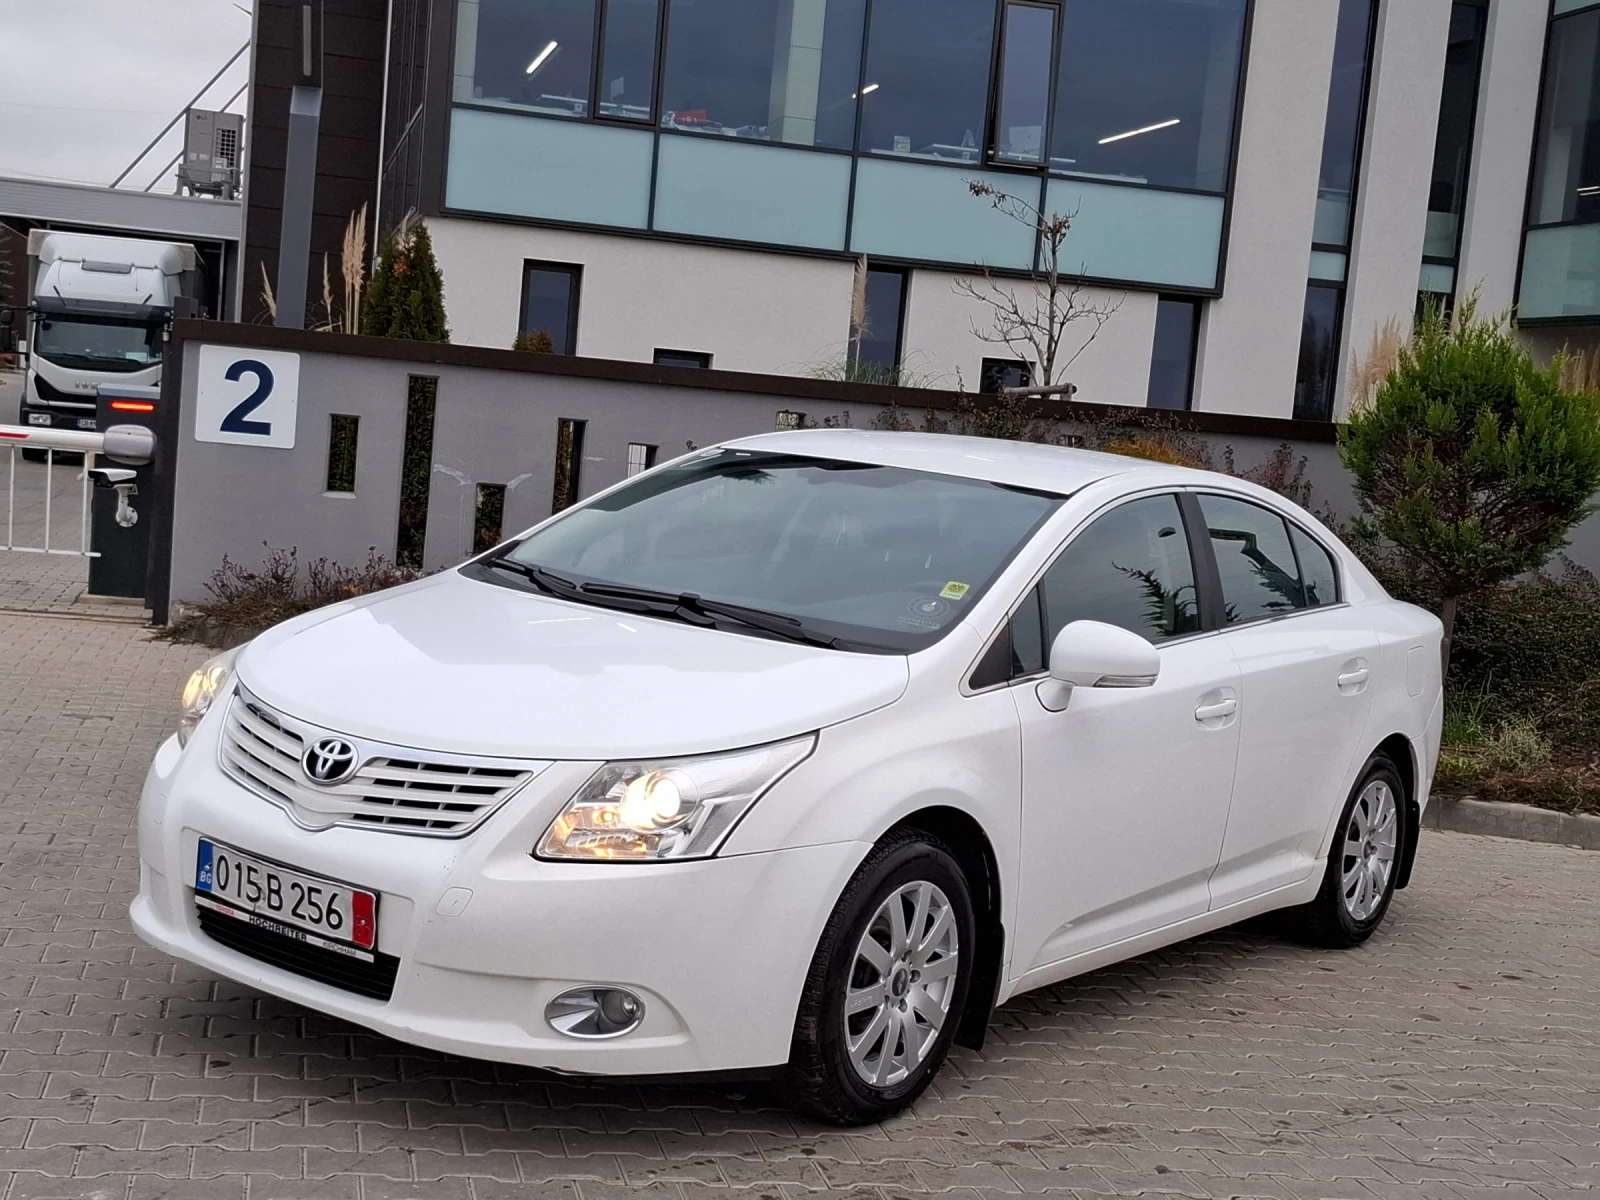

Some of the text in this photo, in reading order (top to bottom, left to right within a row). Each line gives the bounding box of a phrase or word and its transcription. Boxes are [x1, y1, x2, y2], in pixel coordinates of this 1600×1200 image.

[75, 380, 98, 390] IVE
[220, 359, 274, 436] 2
[200, 871, 212, 884] BG
[216, 904, 235, 917] TOYOTA
[249, 916, 307, 942] HOCHREITER
